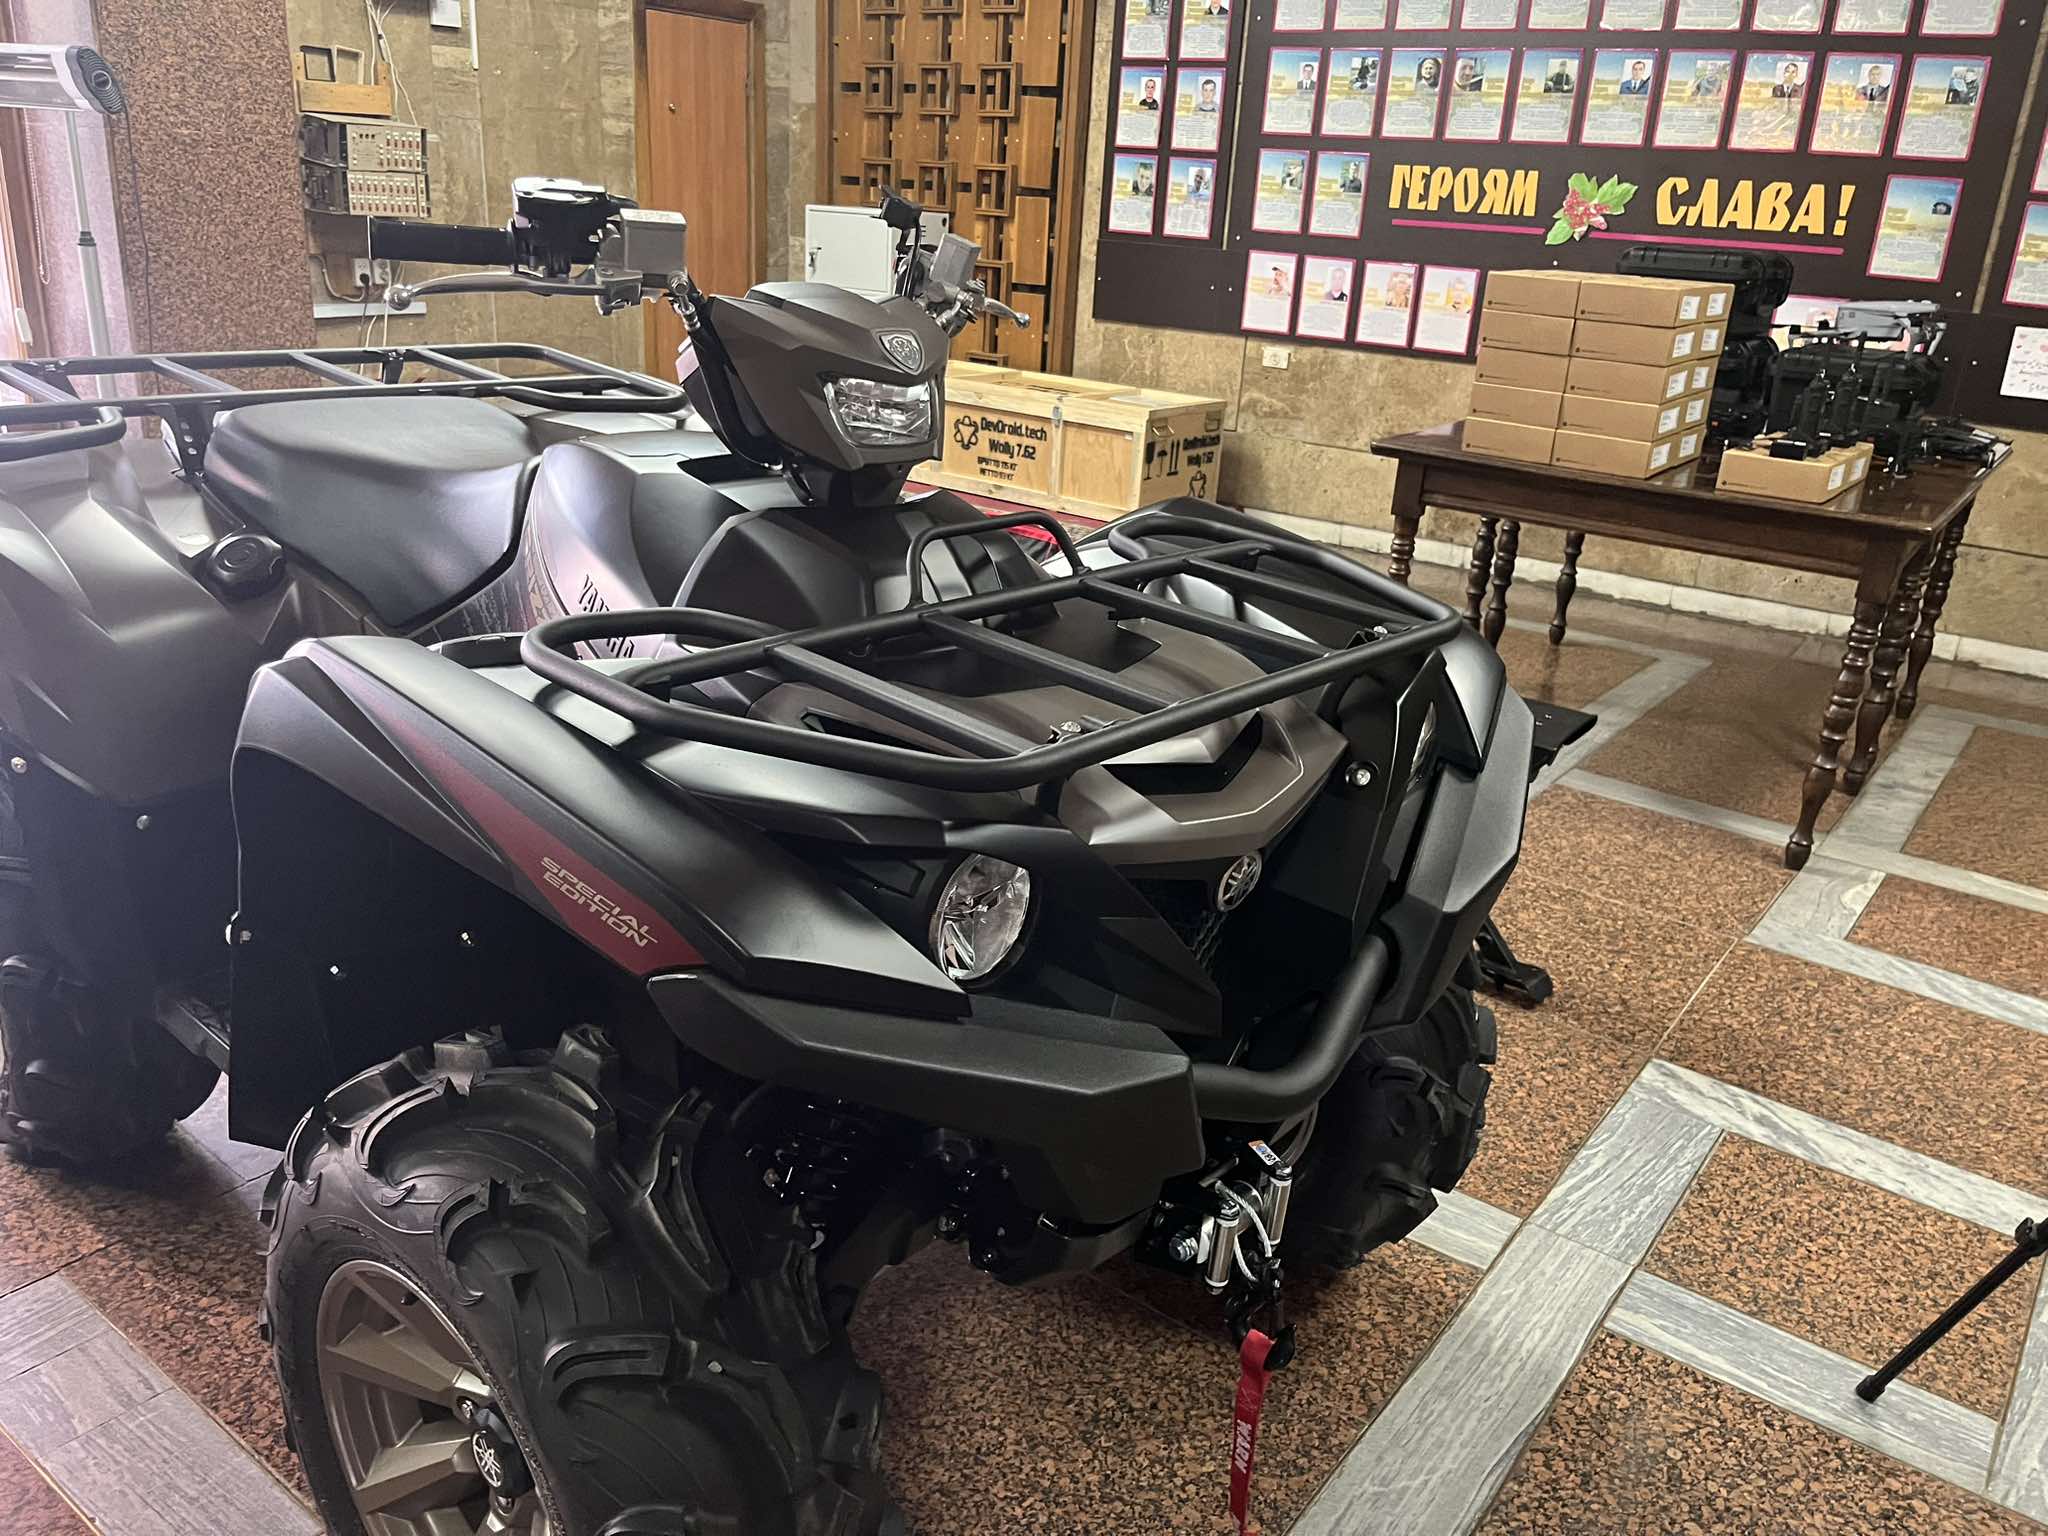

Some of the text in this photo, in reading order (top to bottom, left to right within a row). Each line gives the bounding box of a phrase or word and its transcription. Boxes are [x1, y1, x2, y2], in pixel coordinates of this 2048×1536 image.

[1388, 164, 1856, 236] ГЕРОЯМ СЛАВА!
[980, 416, 1048, 442] DevDroid.tech
[1016, 443, 1037, 460] 7.62
[540, 856, 659, 944] SPECIAL
[543, 871, 649, 947] EDITION
[1234, 1418, 1253, 1475] WARN
